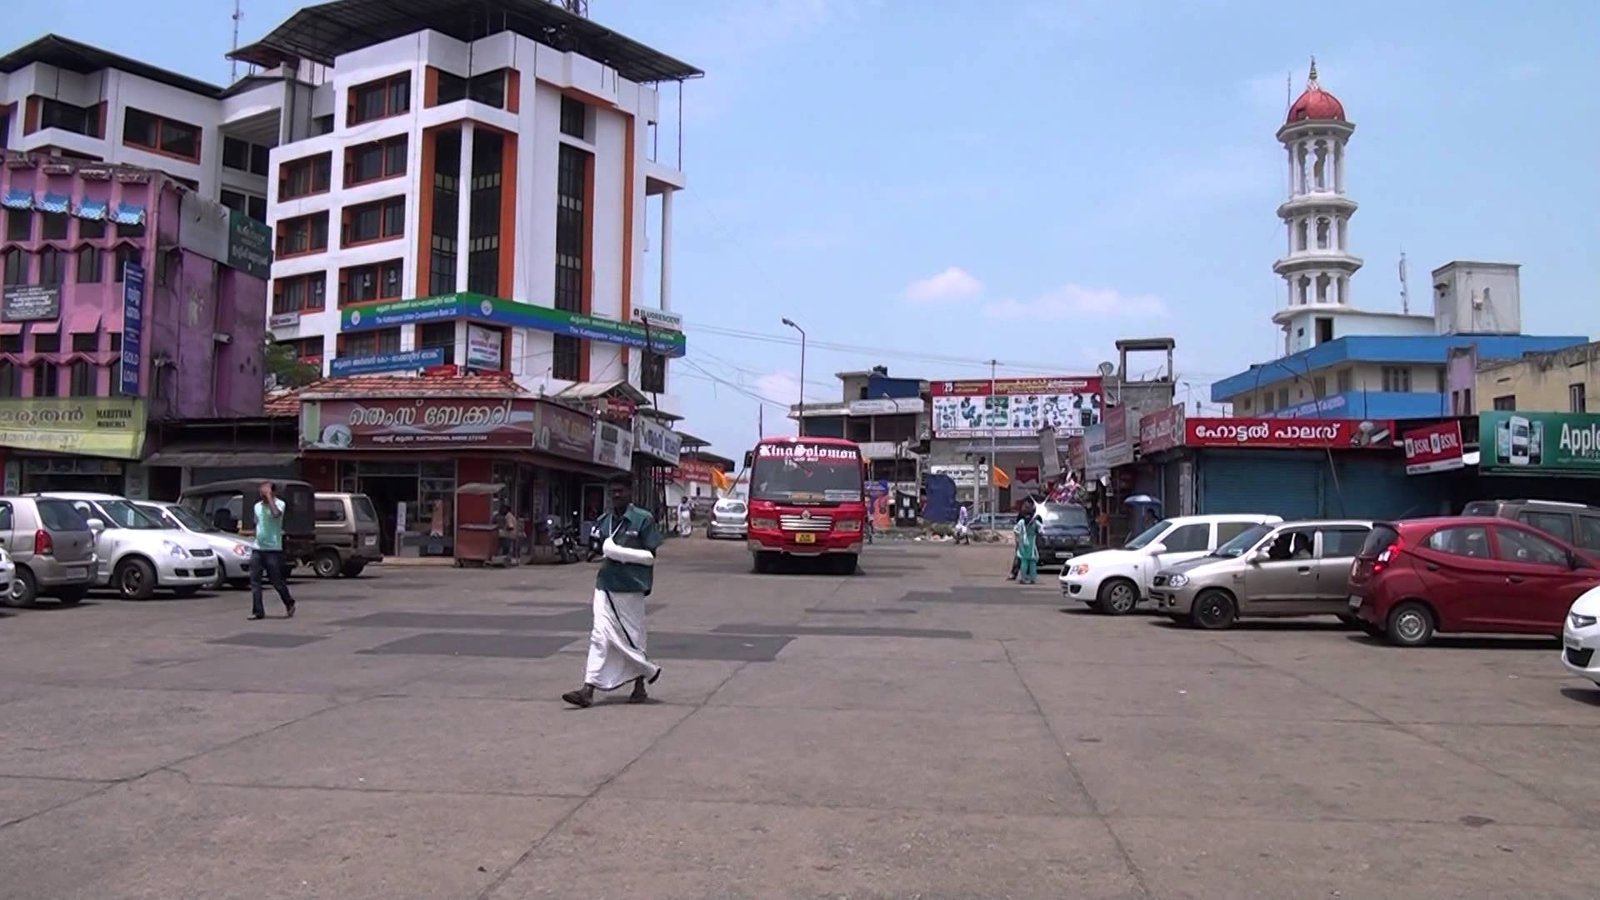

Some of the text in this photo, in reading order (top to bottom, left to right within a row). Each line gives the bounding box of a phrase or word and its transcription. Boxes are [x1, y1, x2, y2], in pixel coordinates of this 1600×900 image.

[424, 400, 513, 426] ബേക്കറി
[1195, 422, 1340, 442] ഹോട്ടൽ പാലസ്
[794, 444, 857, 460] Solomon
[1414, 434, 1458, 454] BSNL BSNL
